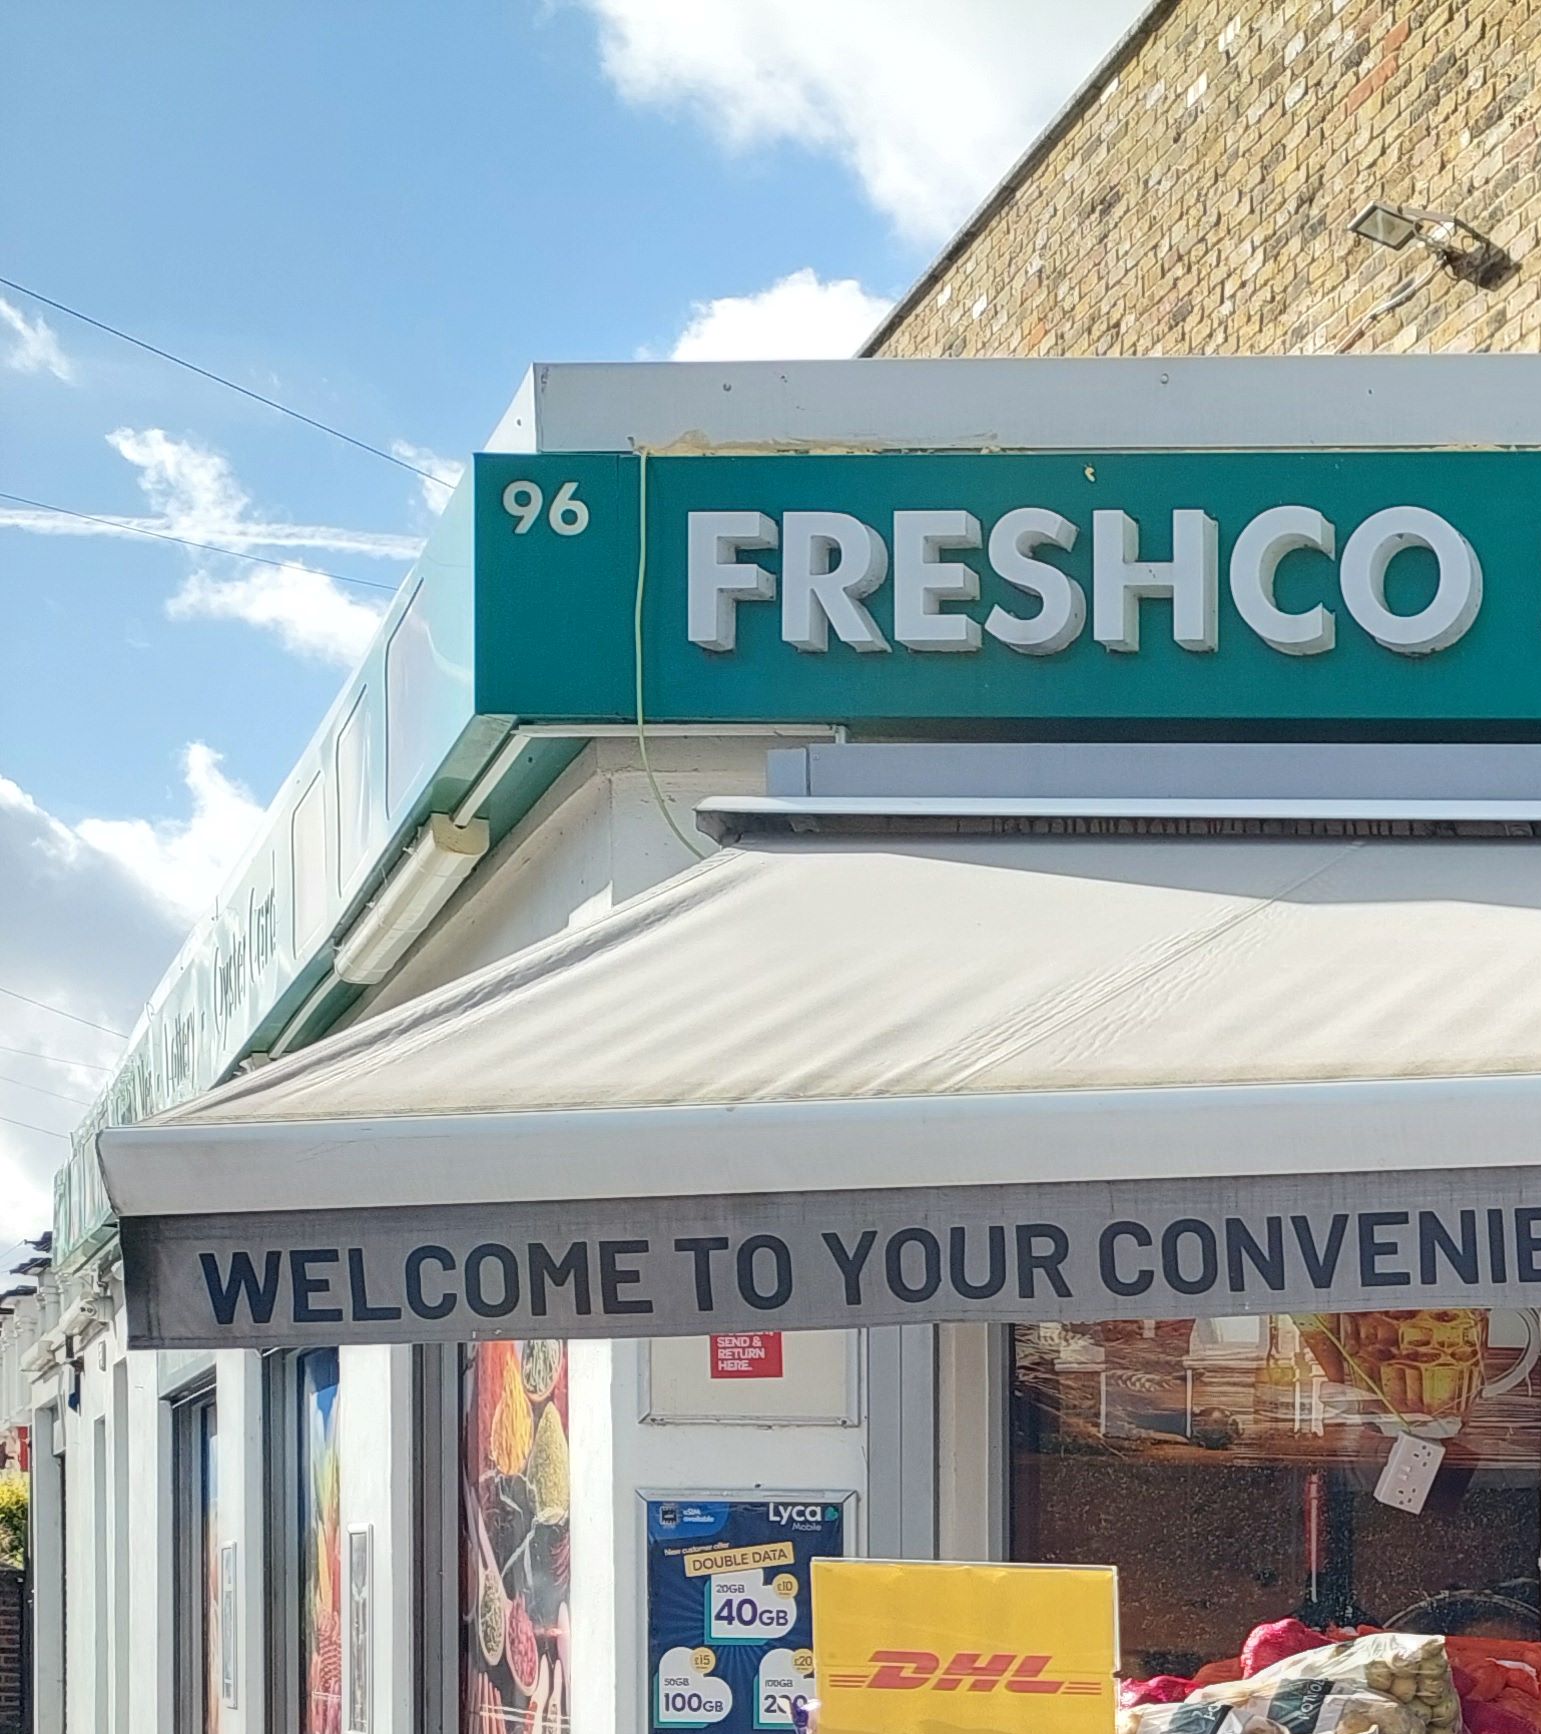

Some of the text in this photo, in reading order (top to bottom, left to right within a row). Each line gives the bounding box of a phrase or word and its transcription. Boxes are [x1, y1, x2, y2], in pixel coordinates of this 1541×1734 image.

[502, 479, 590, 536] 96
[687, 504, 1485, 657] FRESHCO
[201, 1239, 653, 1326] WELCOME
[674, 1233, 793, 1311] TO
[822, 1223, 1072, 1306] YOUR
[717, 1336, 762, 1347] SEND &
[718, 1348, 765, 1359] RETURN
[718, 1360, 753, 1371] HERE.
[769, 1502, 823, 1523] Lyca
[792, 1523, 823, 1532] Mobile
[692, 1548, 788, 1572] DOUBLE DATA
[715, 1584, 745, 1594] 20GB
[777, 1580, 793, 1592] £10
[714, 1598, 789, 1627] 40GB
[694, 1654, 711, 1666] £15
[867, 1650, 1065, 1696] DHL
[664, 1678, 690, 1687] 50GB
[664, 1692, 724, 1713] 100GB
